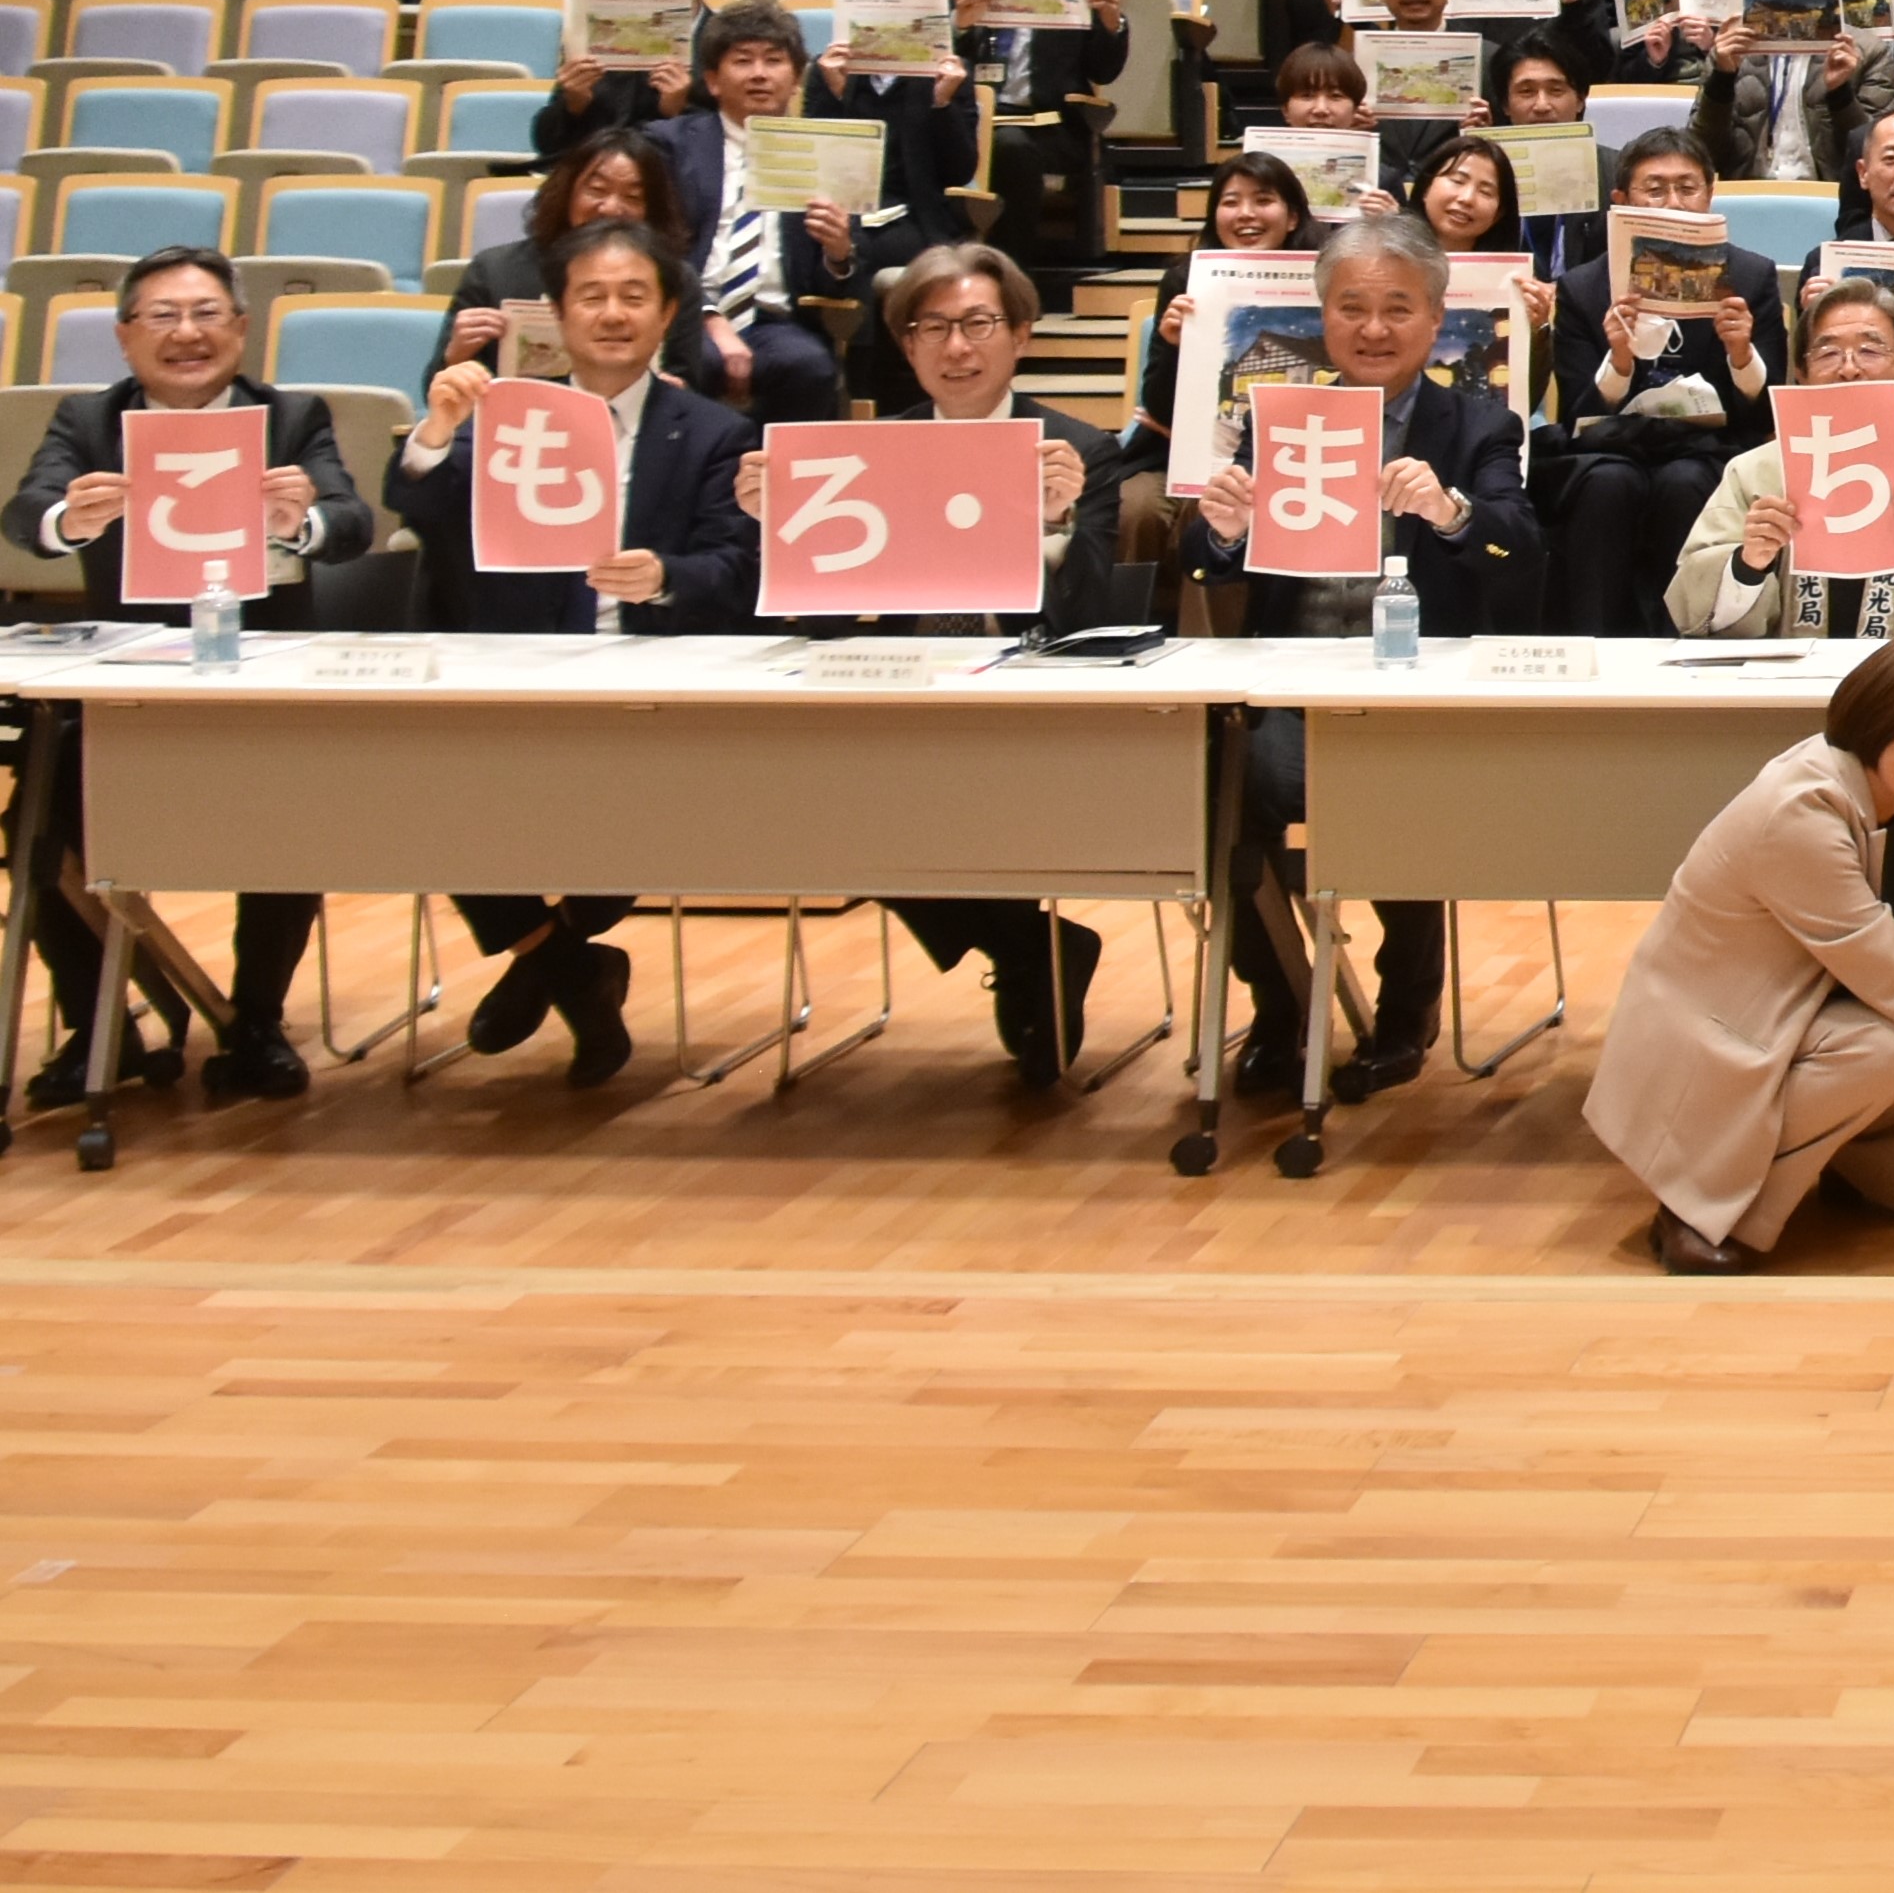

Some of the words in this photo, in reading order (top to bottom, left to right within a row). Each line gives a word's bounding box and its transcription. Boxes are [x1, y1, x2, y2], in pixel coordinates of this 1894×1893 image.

[148, 449, 245, 551] こ
[489, 409, 604, 525] も
[1268, 414, 1364, 531] ま
[1790, 415, 1891, 534] ち
[1499, 648, 1565, 658] こもろ観光局
